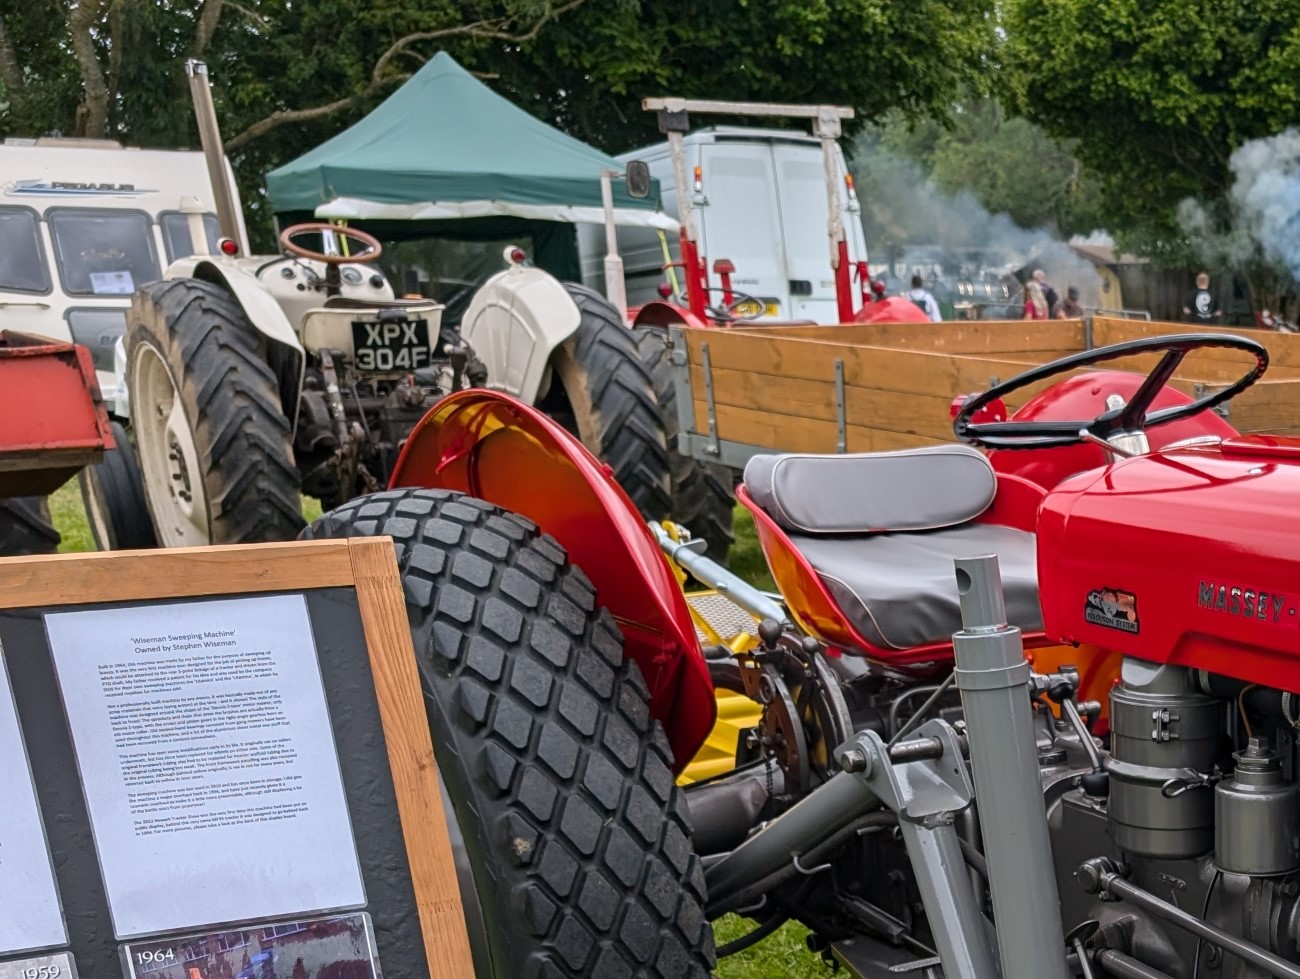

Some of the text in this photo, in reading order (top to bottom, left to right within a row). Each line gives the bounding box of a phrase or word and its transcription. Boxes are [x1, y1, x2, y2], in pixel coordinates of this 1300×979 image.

[364, 322, 418, 345] XPX
[356, 346, 428, 370] 304F
[1087, 612, 1136, 630] FERGUSON SYSTEM
[167, 633, 202, 641] Sweeping
[134, 645, 161, 653] Owned
[136, 948, 175, 965] 1964
